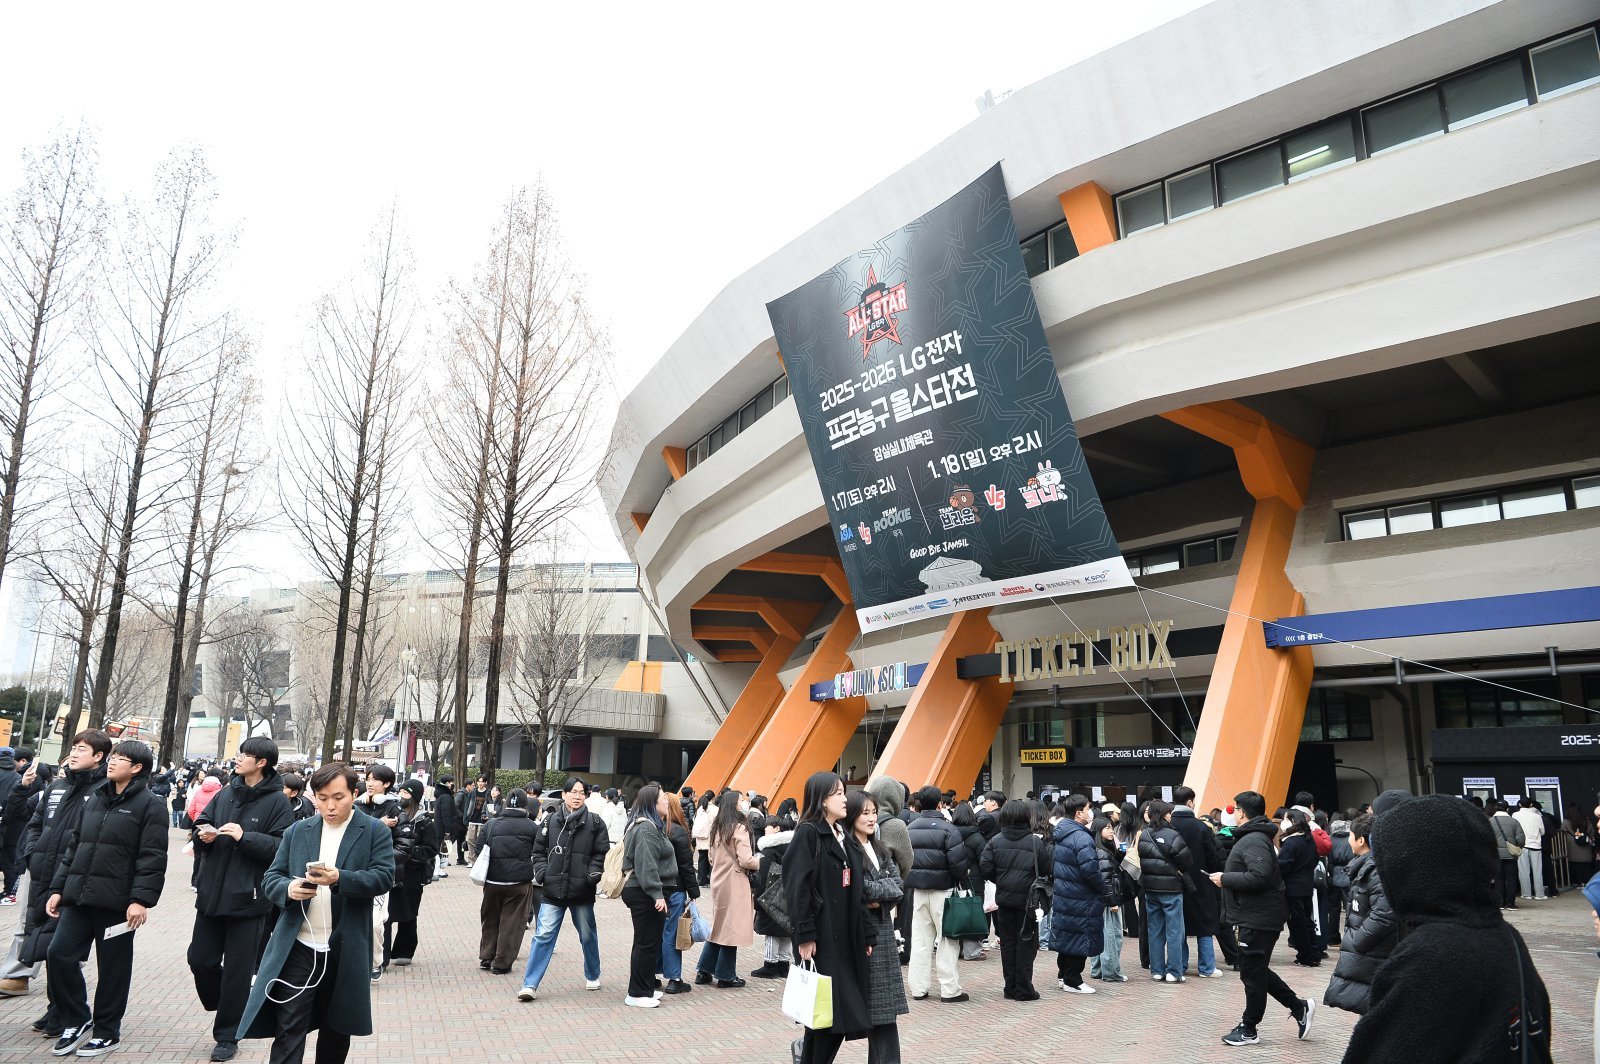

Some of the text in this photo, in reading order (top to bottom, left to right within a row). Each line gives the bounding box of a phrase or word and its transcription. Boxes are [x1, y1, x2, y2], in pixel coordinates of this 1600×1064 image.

[848, 287, 908, 337] ALL STAR
[819, 330, 963, 411] 2025-2026 LG전자
[825, 363, 978, 450] 프로농구 올스타전
[873, 429, 934, 462] 잠실실내체육관
[989, 443, 1012, 461] 오후
[1012, 430, 1042, 454] 2시
[864, 484, 878, 500] 오후
[877, 475, 896, 494] 2시
[984, 484, 1006, 511] VS
[1018, 484, 1038, 493] TEAM
[1021, 484, 1059, 509] 코니
[873, 508, 912, 533] ROOKIE
[882, 507, 898, 518] TEAM
[939, 506, 954, 514] TEAM
[940, 507, 975, 530] 브라운
[858, 521, 872, 545] VS
[1002, 585, 1025, 593] Sports
[1084, 573, 1106, 582] KSPO
[995, 619, 1176, 683] TICKET BOX
[881, 661, 909, 692] SOUL
[1561, 735, 1600, 745] 2025-
[1024, 750, 1064, 761] TICKET BOX
[1099, 750, 1132, 758] 2025-2026
[1132, 749, 1156, 757] LG전자
[1156, 748, 1181, 758] 프로농구
